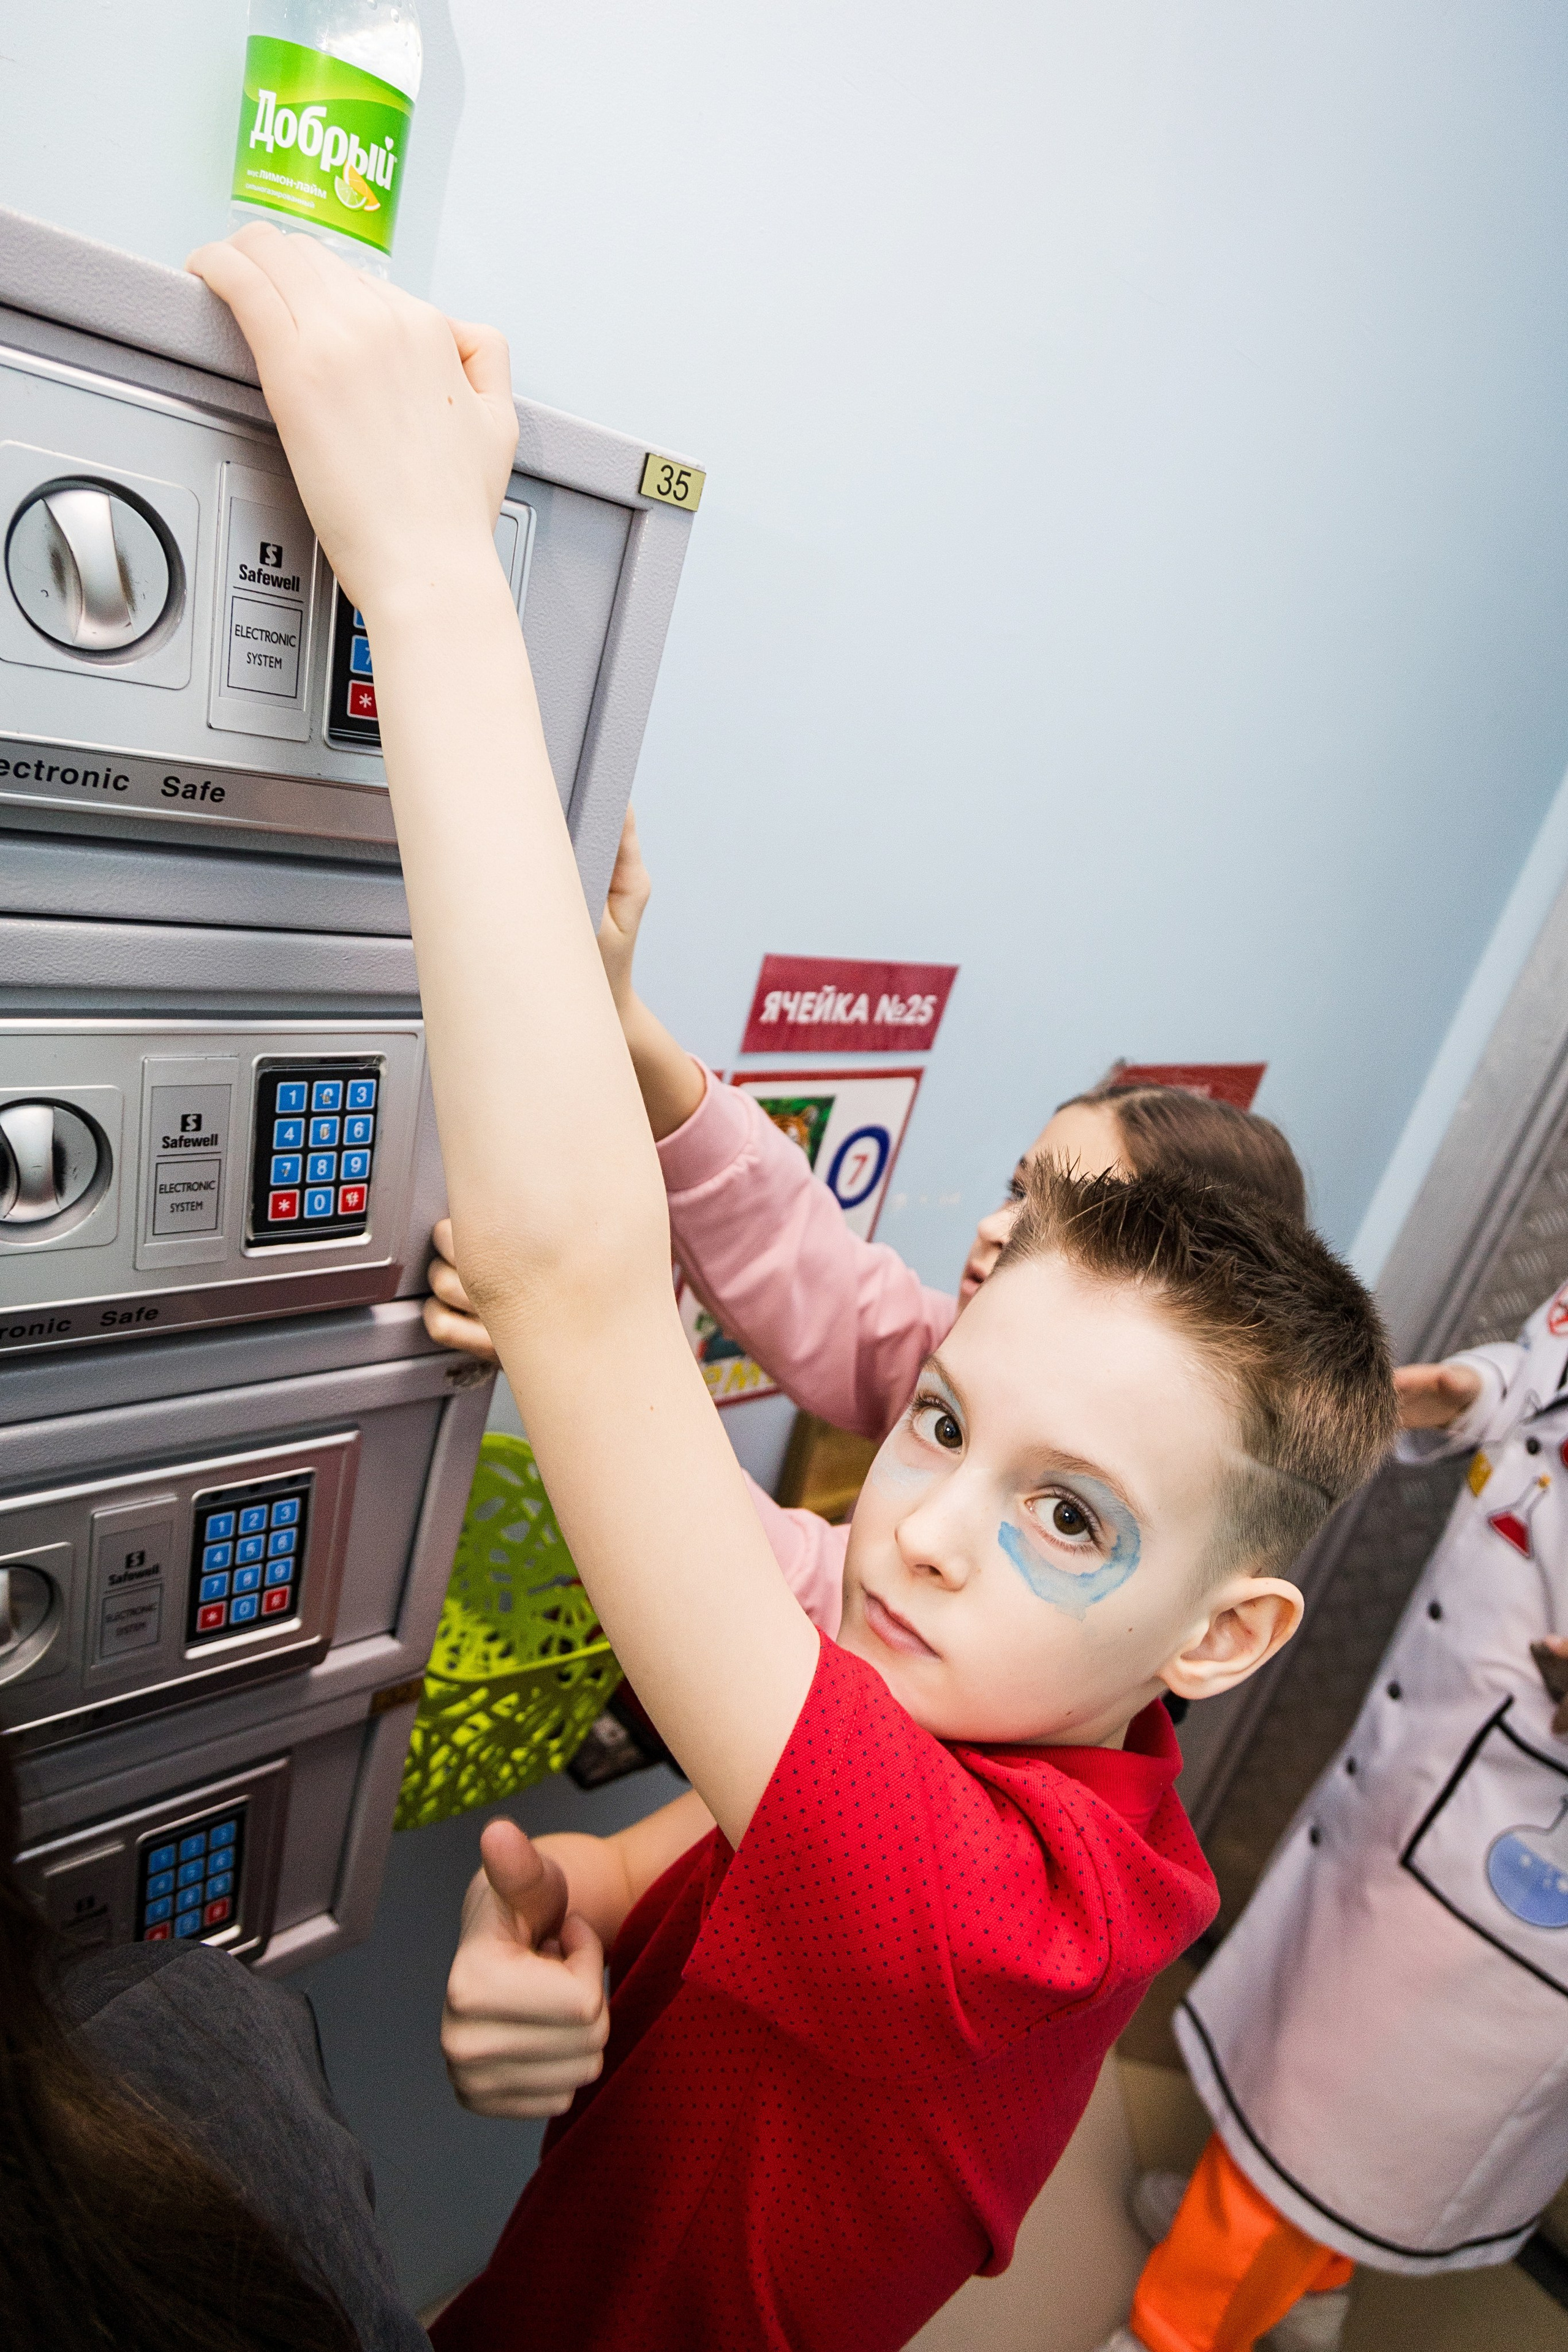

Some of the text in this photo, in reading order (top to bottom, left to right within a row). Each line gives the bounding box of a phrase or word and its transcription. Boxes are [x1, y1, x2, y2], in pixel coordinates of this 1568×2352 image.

[249, 89, 395, 190] Добрый
[657, 464, 692, 501] 35
[239, 564, 300, 592] Safewell
[235, 624, 297, 647] ELECTRONIC
[246, 652, 282, 669] SYSTEM
[160, 775, 225, 802] Safe
[760, 984, 938, 1027] ЯЧЕЙКА №25
[288, 1089, 297, 1105] 1
[356, 1086, 368, 1103] 3
[162, 1133, 219, 1149] Safewell
[284, 1126, 295, 1140] 4
[353, 1121, 365, 1138] 6
[282, 1156, 363, 1177] 7 8 9
[848, 1153, 870, 1187] 7
[159, 1180, 216, 1194] ELECTRONIC
[170, 1200, 203, 1213] SYSTEM
[314, 1194, 326, 1212] 0
[100, 1306, 159, 1327] Safe
[248, 1512, 260, 1528] 2
[280, 1505, 292, 1521] 3
